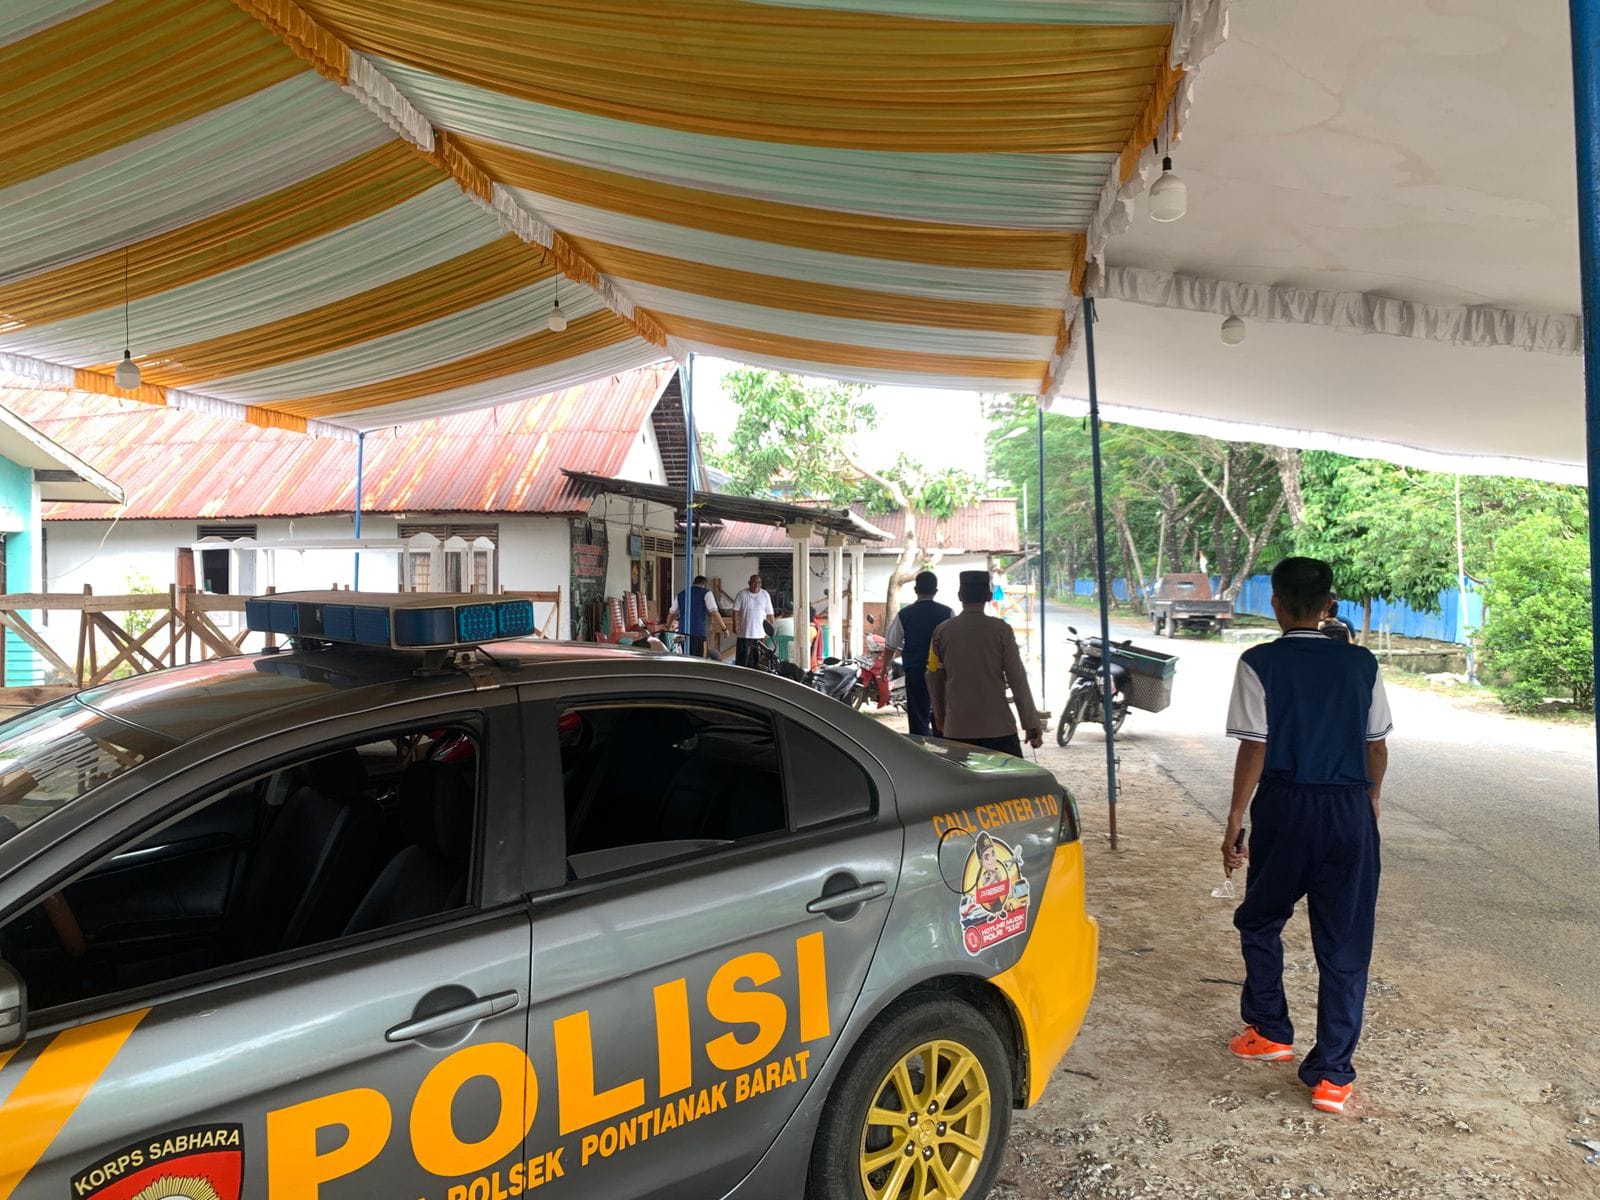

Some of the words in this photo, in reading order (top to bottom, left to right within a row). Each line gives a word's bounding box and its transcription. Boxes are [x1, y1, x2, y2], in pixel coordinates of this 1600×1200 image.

[933, 810, 977, 841] CALL
[976, 798, 1035, 829] CENTER
[1035, 794, 1058, 816] 110
[266, 931, 830, 1200] POLISI
[581, 1081, 728, 1167] PONTIANAK
[735, 1050, 810, 1103] BARAT
[74, 1150, 144, 1196] KORPS
[149, 1129, 240, 1160] SABHARA
